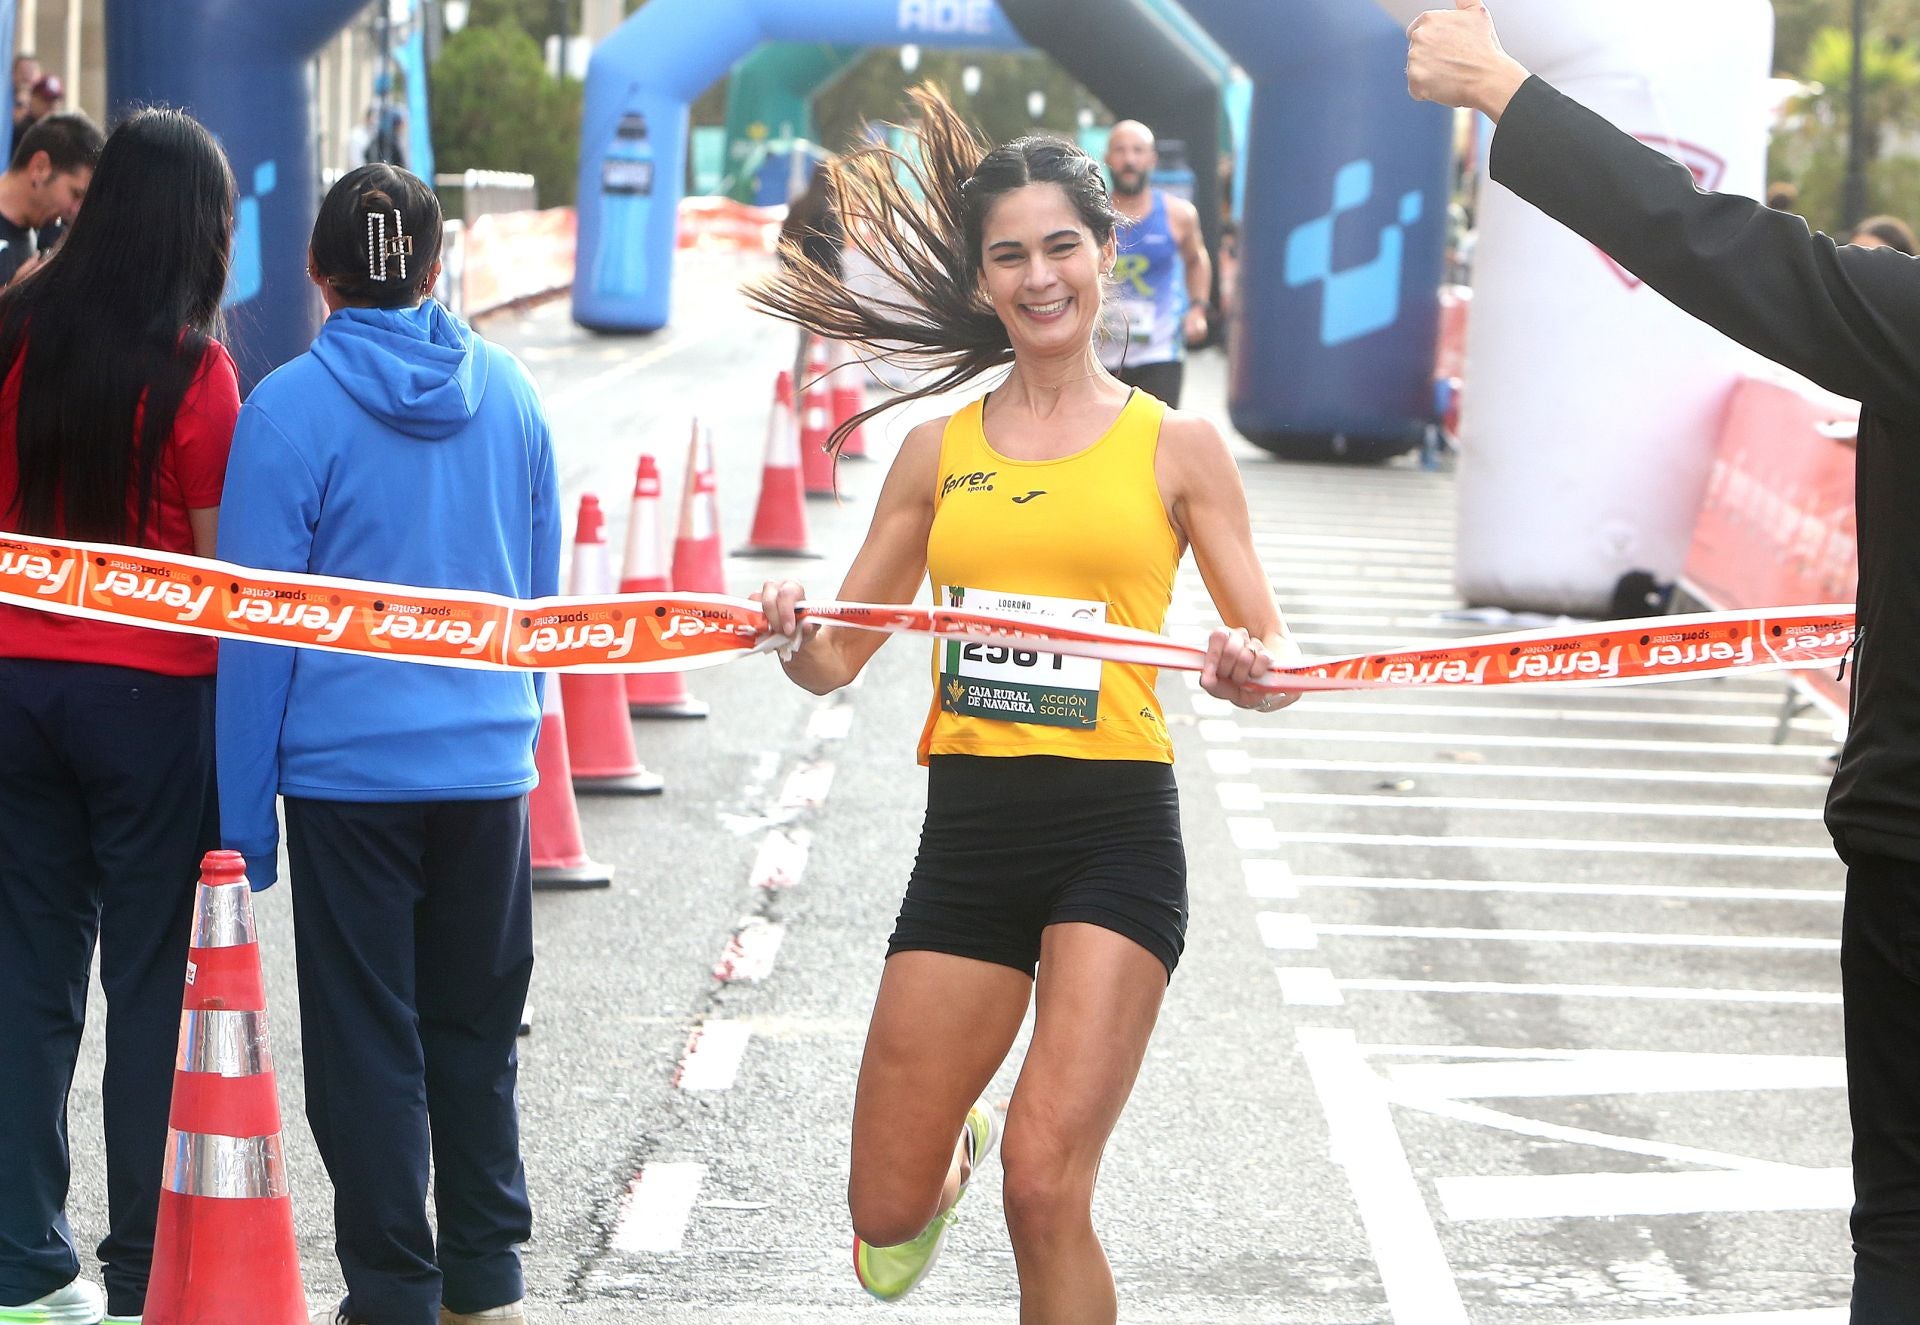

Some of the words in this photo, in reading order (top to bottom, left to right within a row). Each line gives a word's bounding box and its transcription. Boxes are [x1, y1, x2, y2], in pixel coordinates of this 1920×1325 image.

[941, 472, 997, 499] Ferrer
[94, 570, 215, 622] Ferrer
[241, 586, 308, 601] sportcenter
[998, 598, 1032, 611] LOGROÑO
[227, 598, 355, 642] Ferrer
[387, 603, 452, 617] sportcenter
[369, 614, 497, 655] Ferrer
[517, 617, 637, 659] Ferrer
[1508, 644, 1623, 679] Ferrer
[1643, 636, 1754, 668] Ferrer
[1376, 650, 1492, 685] Ferrer
[967, 696, 981, 707] DE
[982, 698, 1036, 714] NAVARRA
[968, 685, 993, 699] CAJA
[993, 687, 1031, 703] RURAL
[1040, 694, 1087, 707] ACCIÓN
[1040, 705, 1086, 718] SOCIAL
